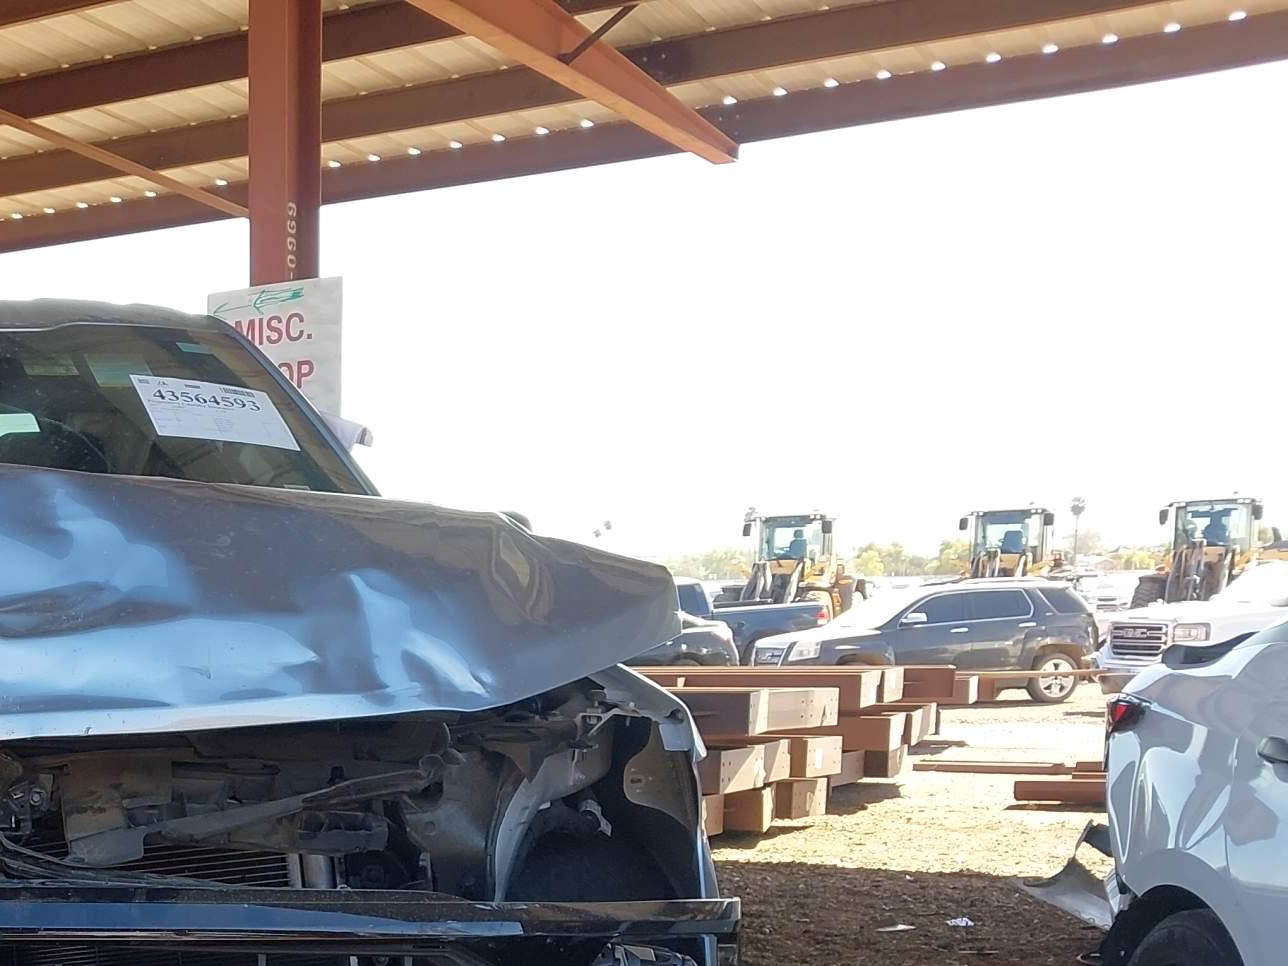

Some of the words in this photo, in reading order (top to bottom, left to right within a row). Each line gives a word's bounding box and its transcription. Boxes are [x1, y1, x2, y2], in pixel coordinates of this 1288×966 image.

[234, 312, 312, 345] MISC.
[278, 360, 314, 388] OP
[152, 388, 261, 412] 43564593
